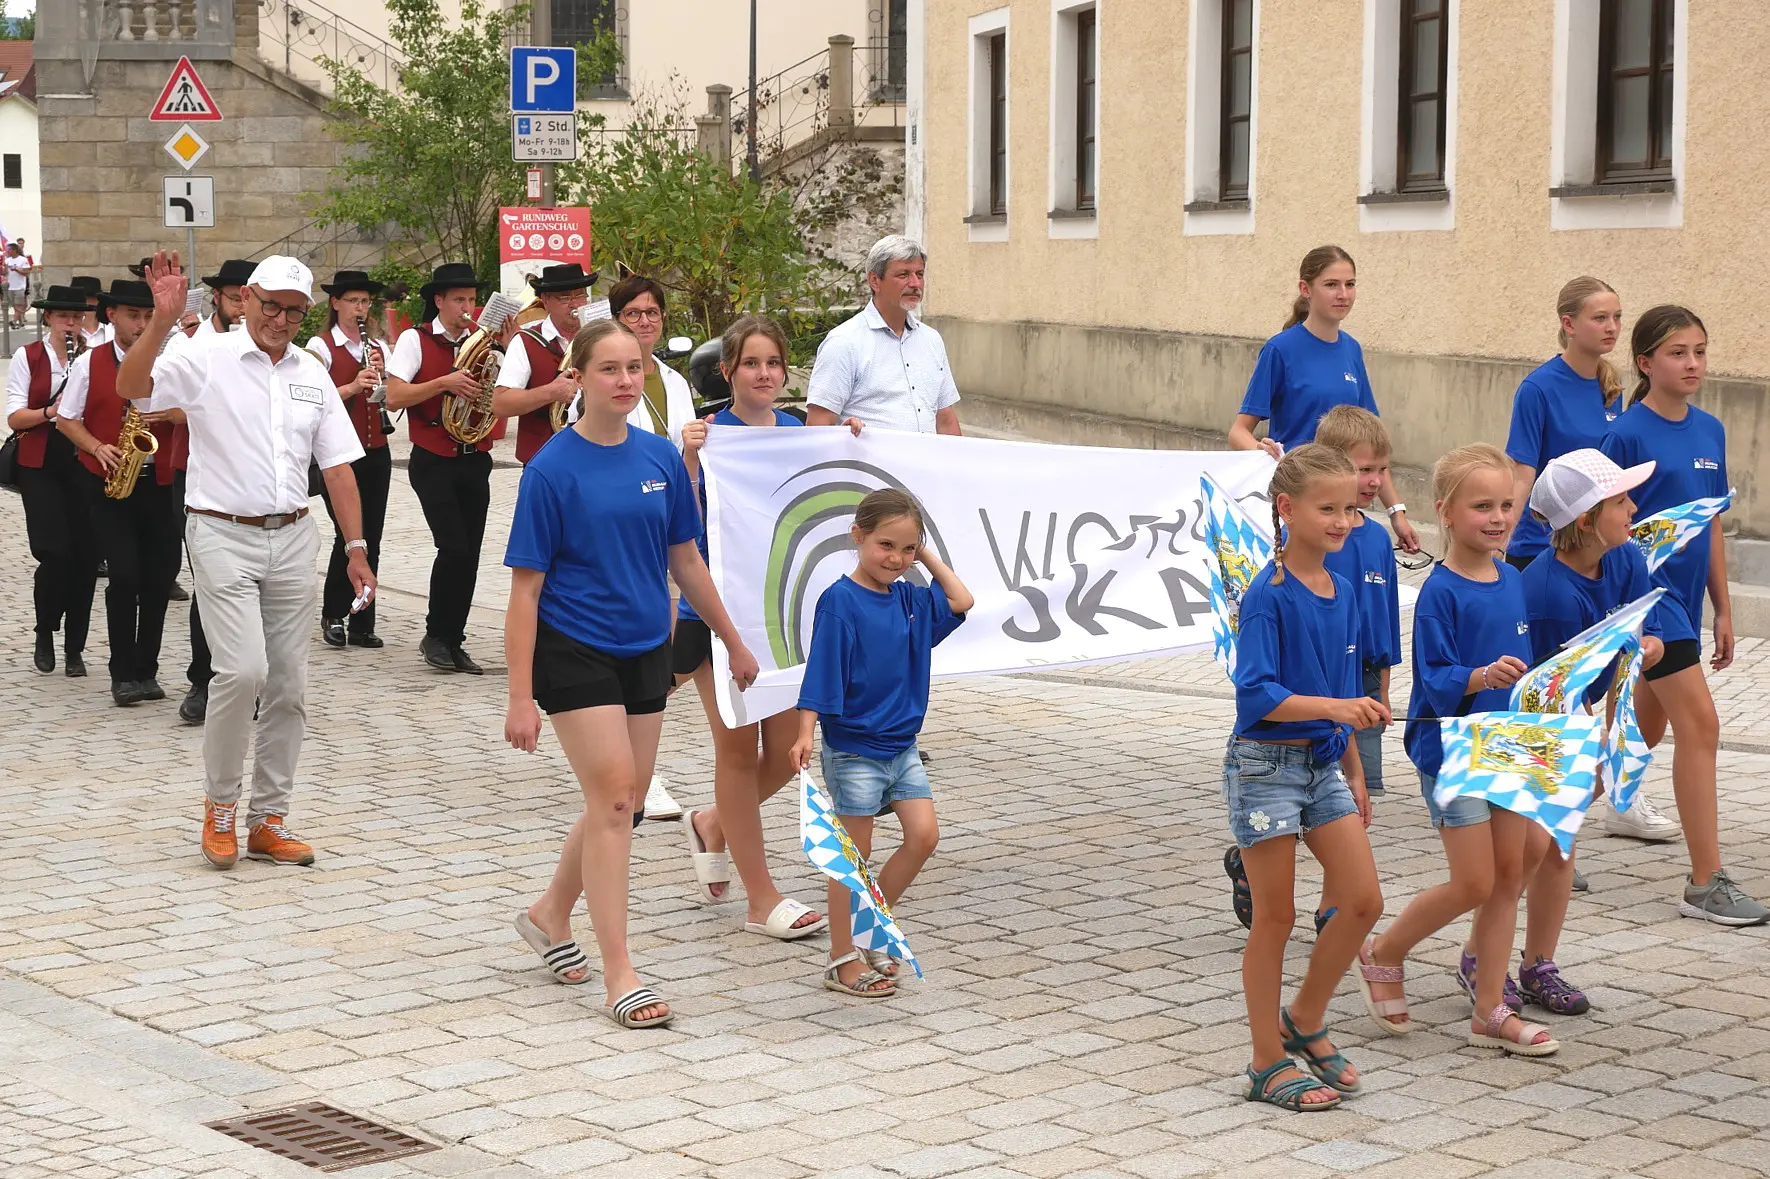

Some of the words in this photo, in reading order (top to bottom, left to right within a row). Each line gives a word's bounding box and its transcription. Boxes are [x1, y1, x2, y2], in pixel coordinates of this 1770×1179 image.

[526, 55, 560, 104] P
[535, 121, 542, 132] 2
[547, 120, 571, 132] Std.
[518, 137, 544, 146] Mo-Fr
[548, 137, 570, 146] 9-18h
[527, 147, 538, 156] Sa
[541, 147, 563, 156] 9-12h
[522, 213, 568, 222] RUNDWEG
[511, 222, 579, 231] GARTENSCHAU
